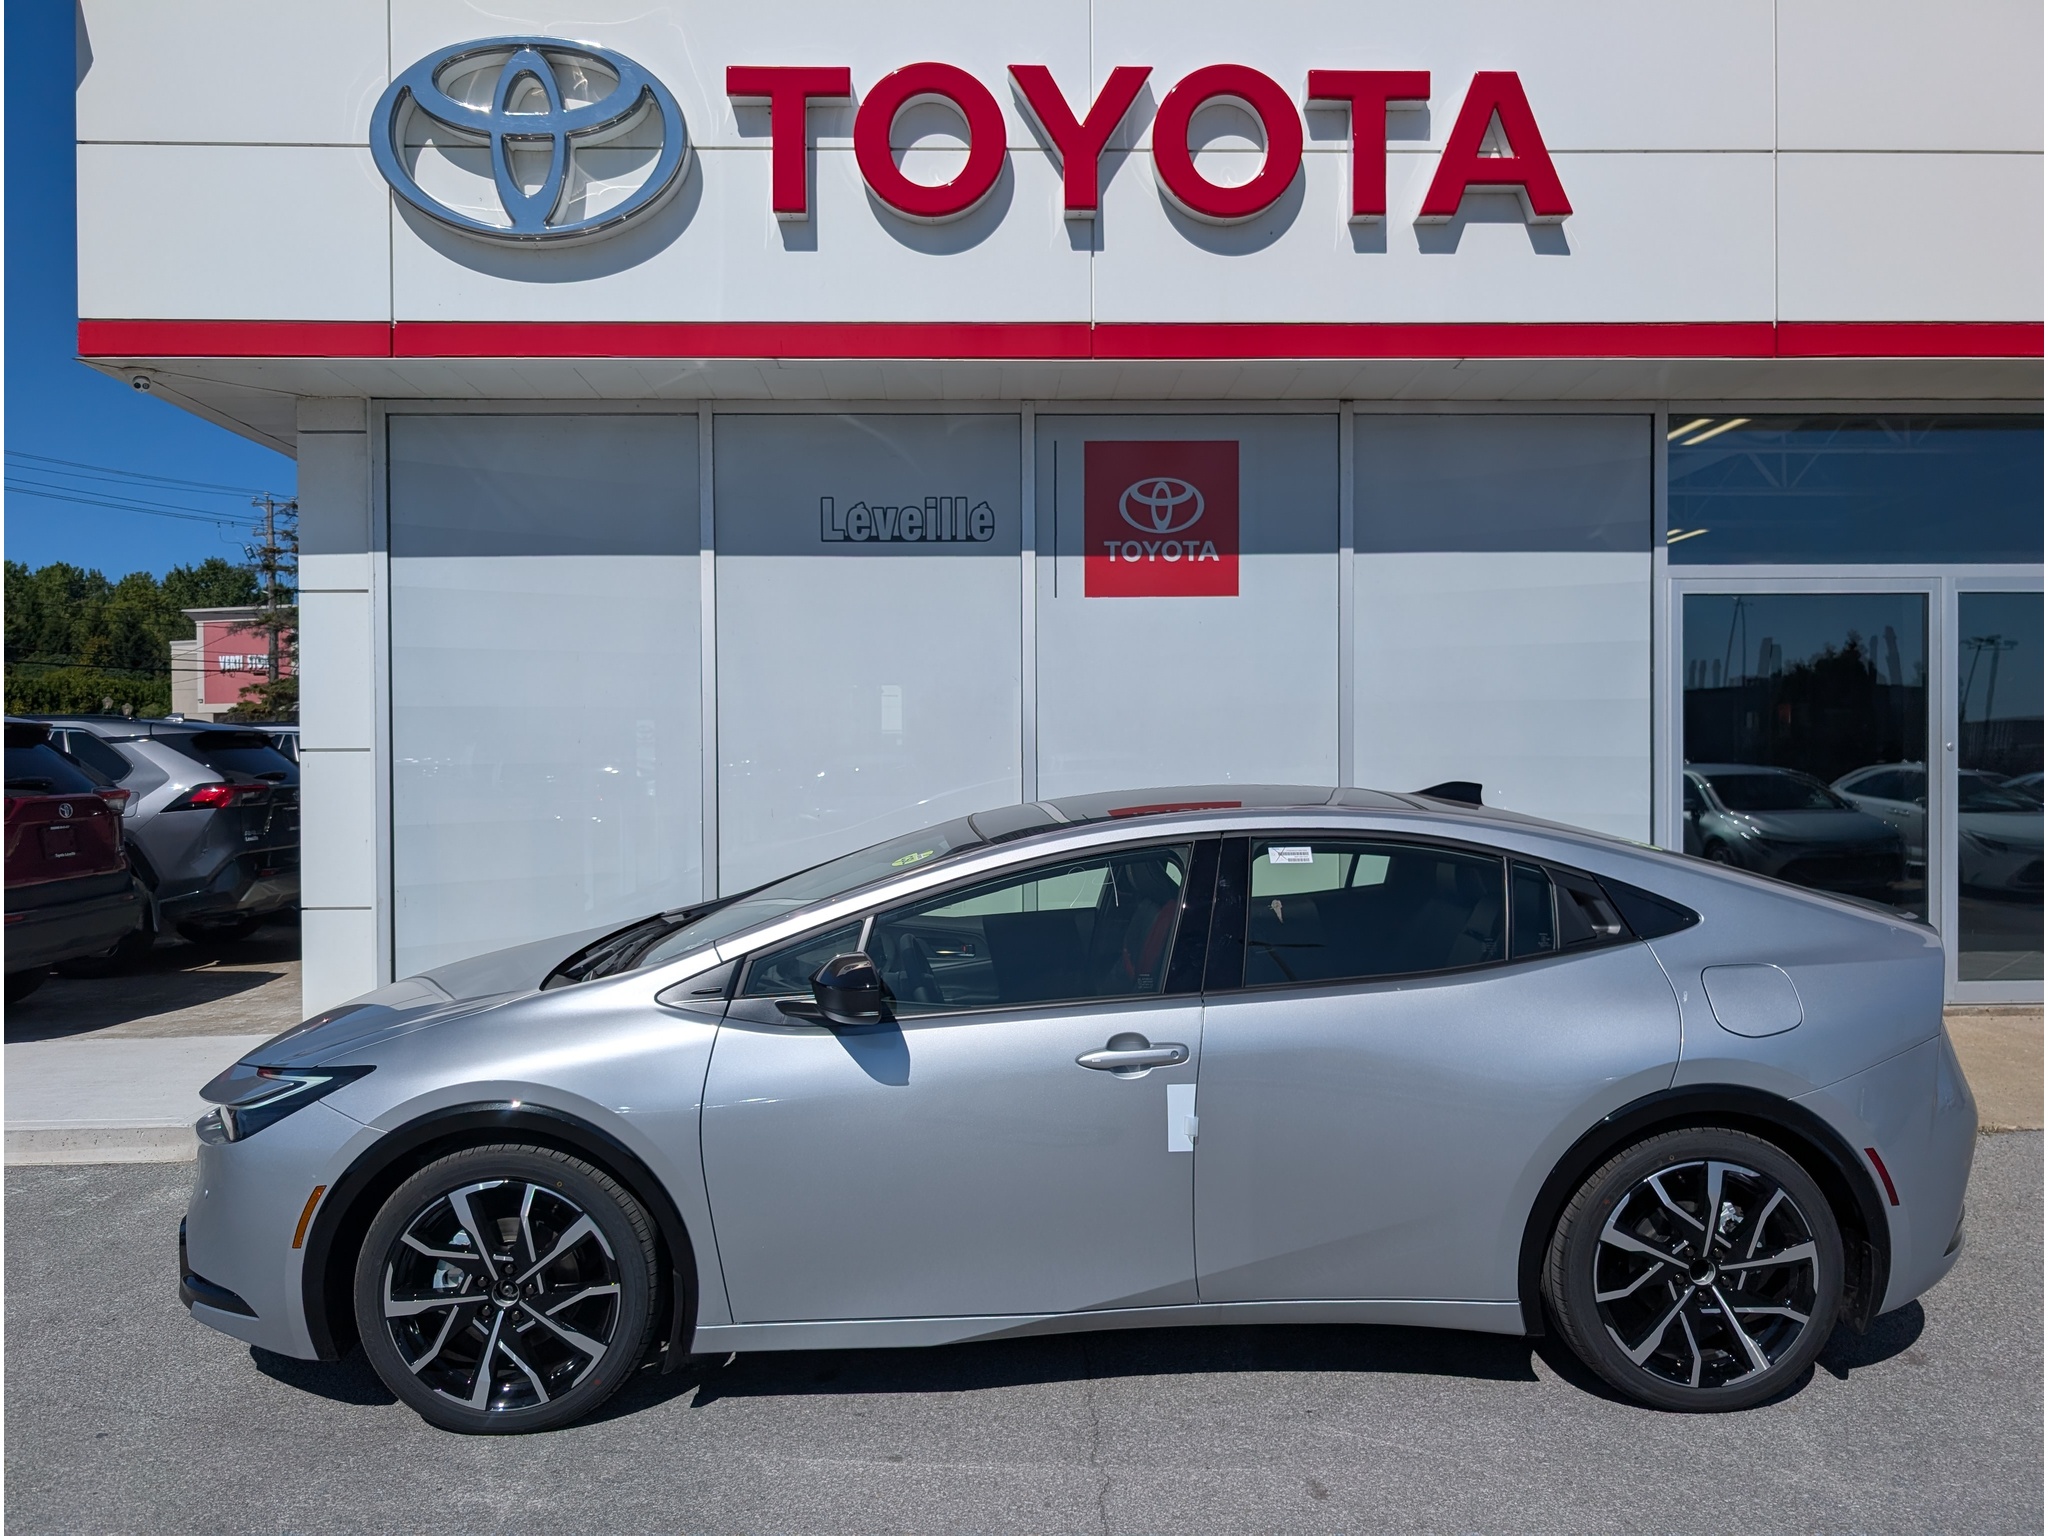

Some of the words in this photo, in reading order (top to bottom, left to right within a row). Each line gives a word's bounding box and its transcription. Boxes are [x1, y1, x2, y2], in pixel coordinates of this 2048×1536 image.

[726, 62, 1573, 221] TOYOTA
[821, 497, 995, 542] Léveillé
[1104, 540, 1220, 563] TOYOTA
